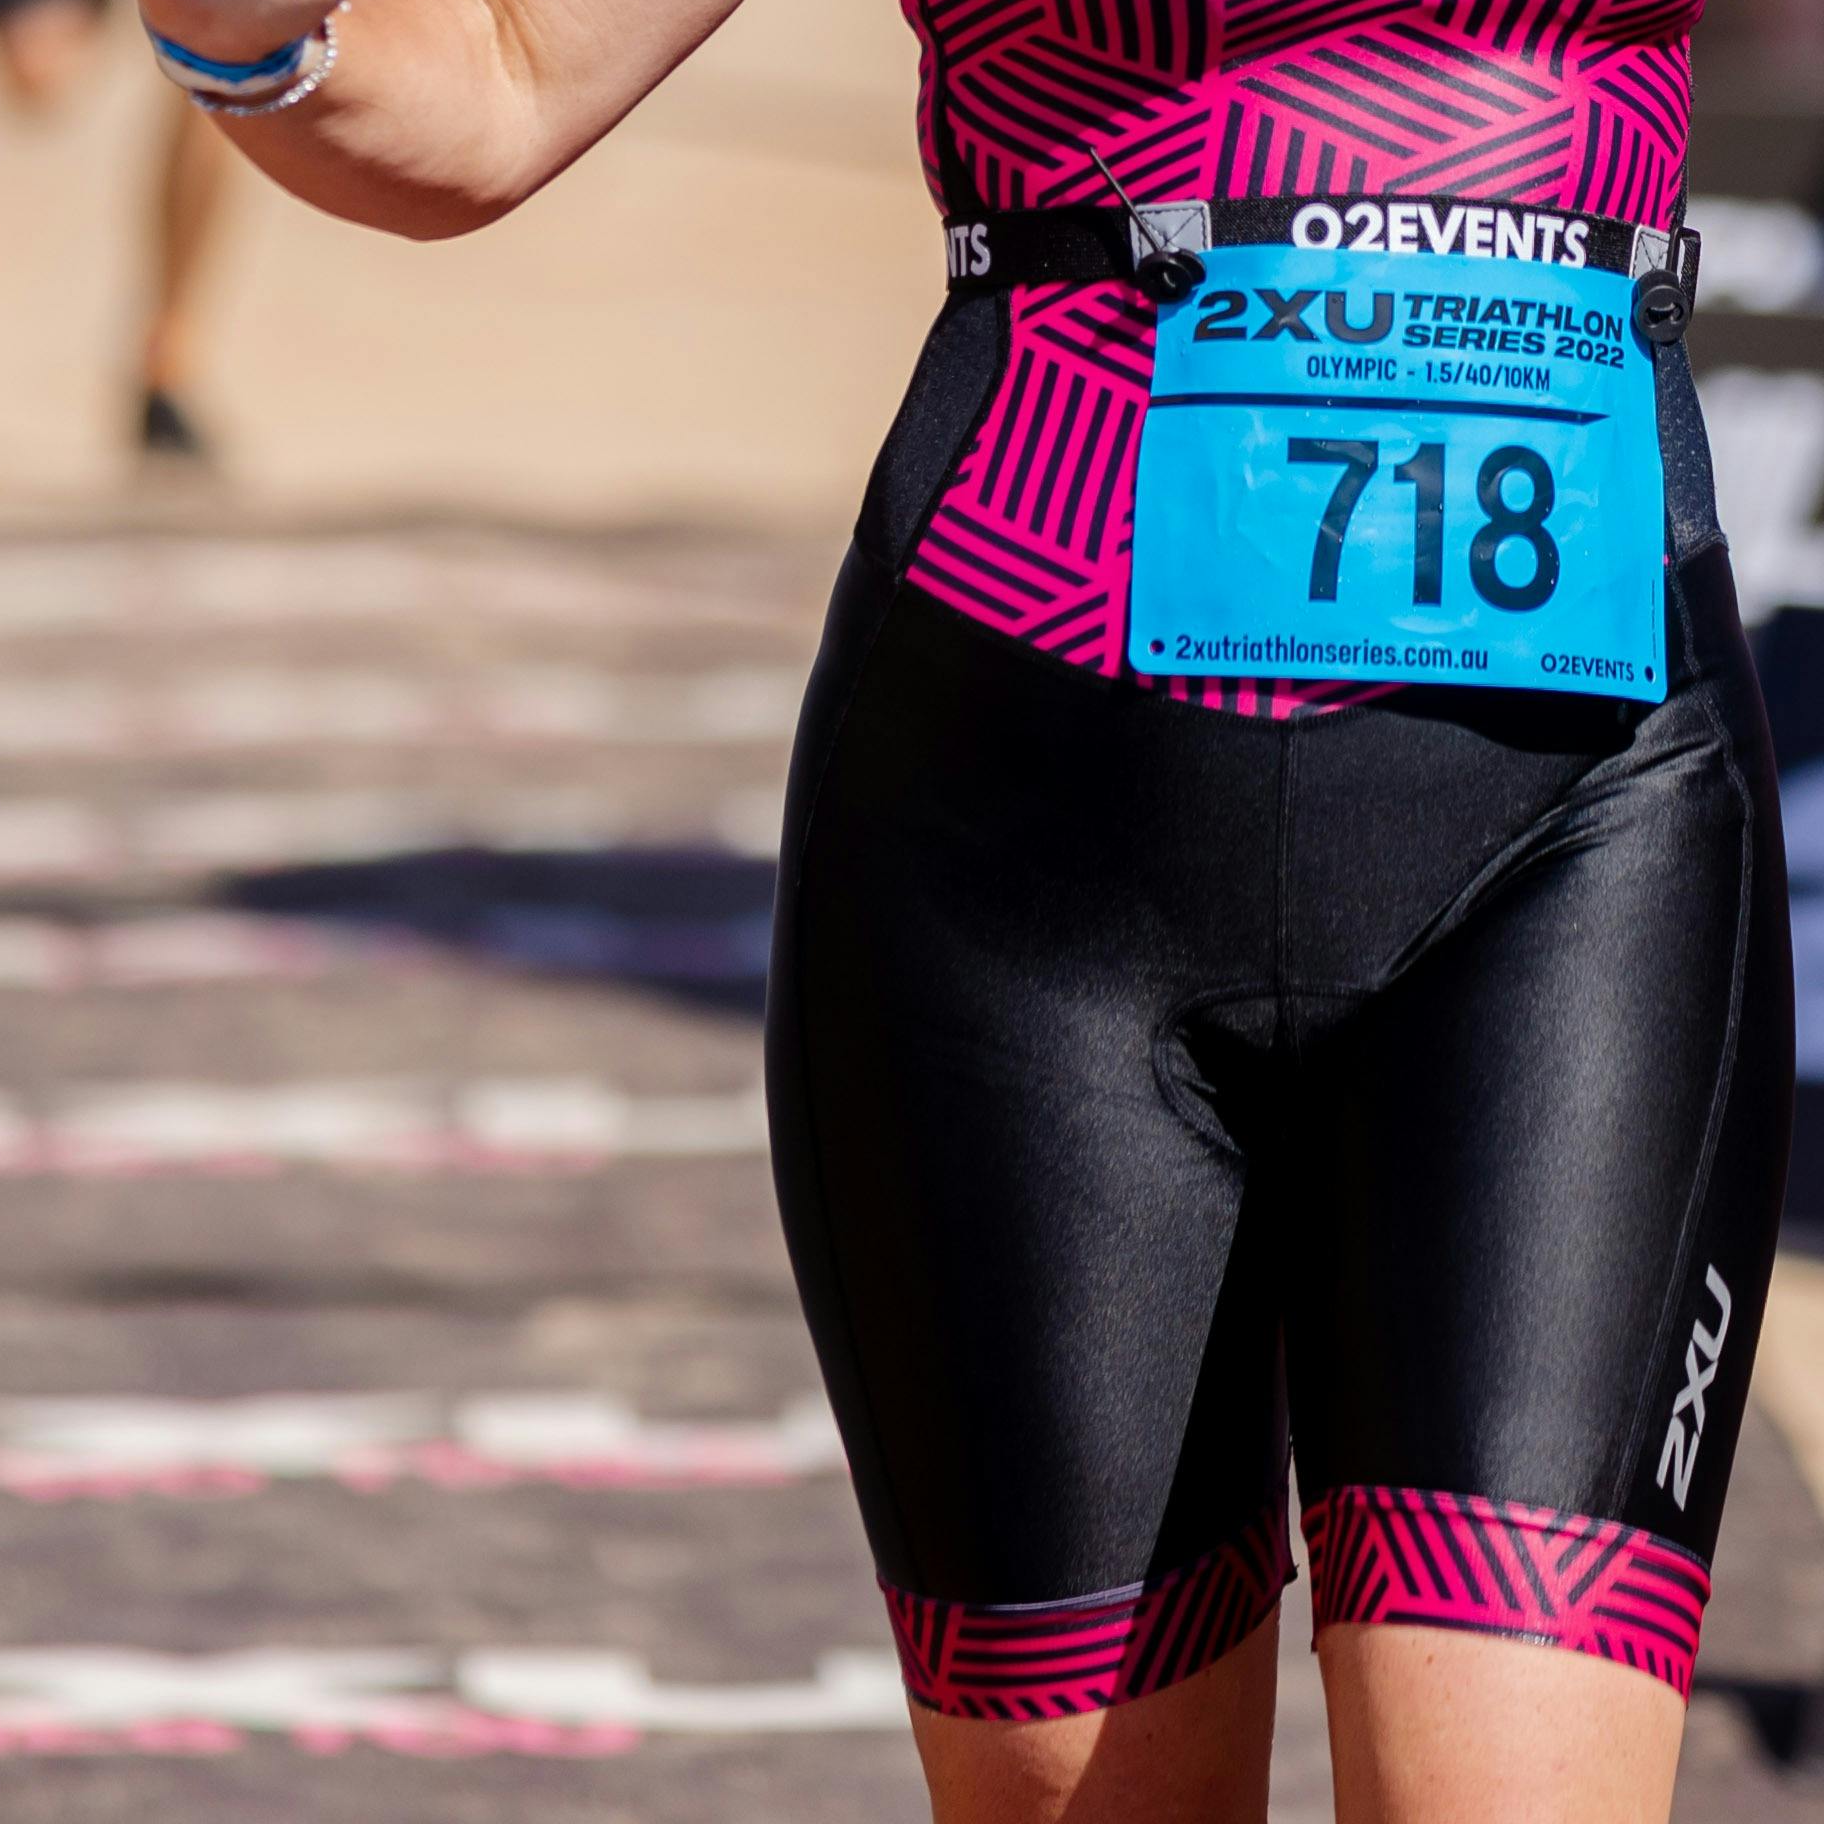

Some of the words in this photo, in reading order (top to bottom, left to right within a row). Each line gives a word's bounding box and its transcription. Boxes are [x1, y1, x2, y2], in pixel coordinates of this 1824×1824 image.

[1291, 203, 1589, 268] O2EVENTS
[1193, 289, 1395, 344] 2XU
[1402, 293, 1624, 343] TRIATHLON
[1401, 324, 1546, 357] SERIES
[1554, 335, 1625, 369] 2022
[1306, 355, 1398, 382] OLYMPIC
[1425, 360, 1551, 392] 1.5/40/10KM
[1286, 436, 1563, 613] 718
[1175, 633, 1489, 671] 2xutriathlonseries.com.au
[1540, 652, 1636, 683] O2EVENTS
[1656, 1262, 1732, 1513] 2XU
